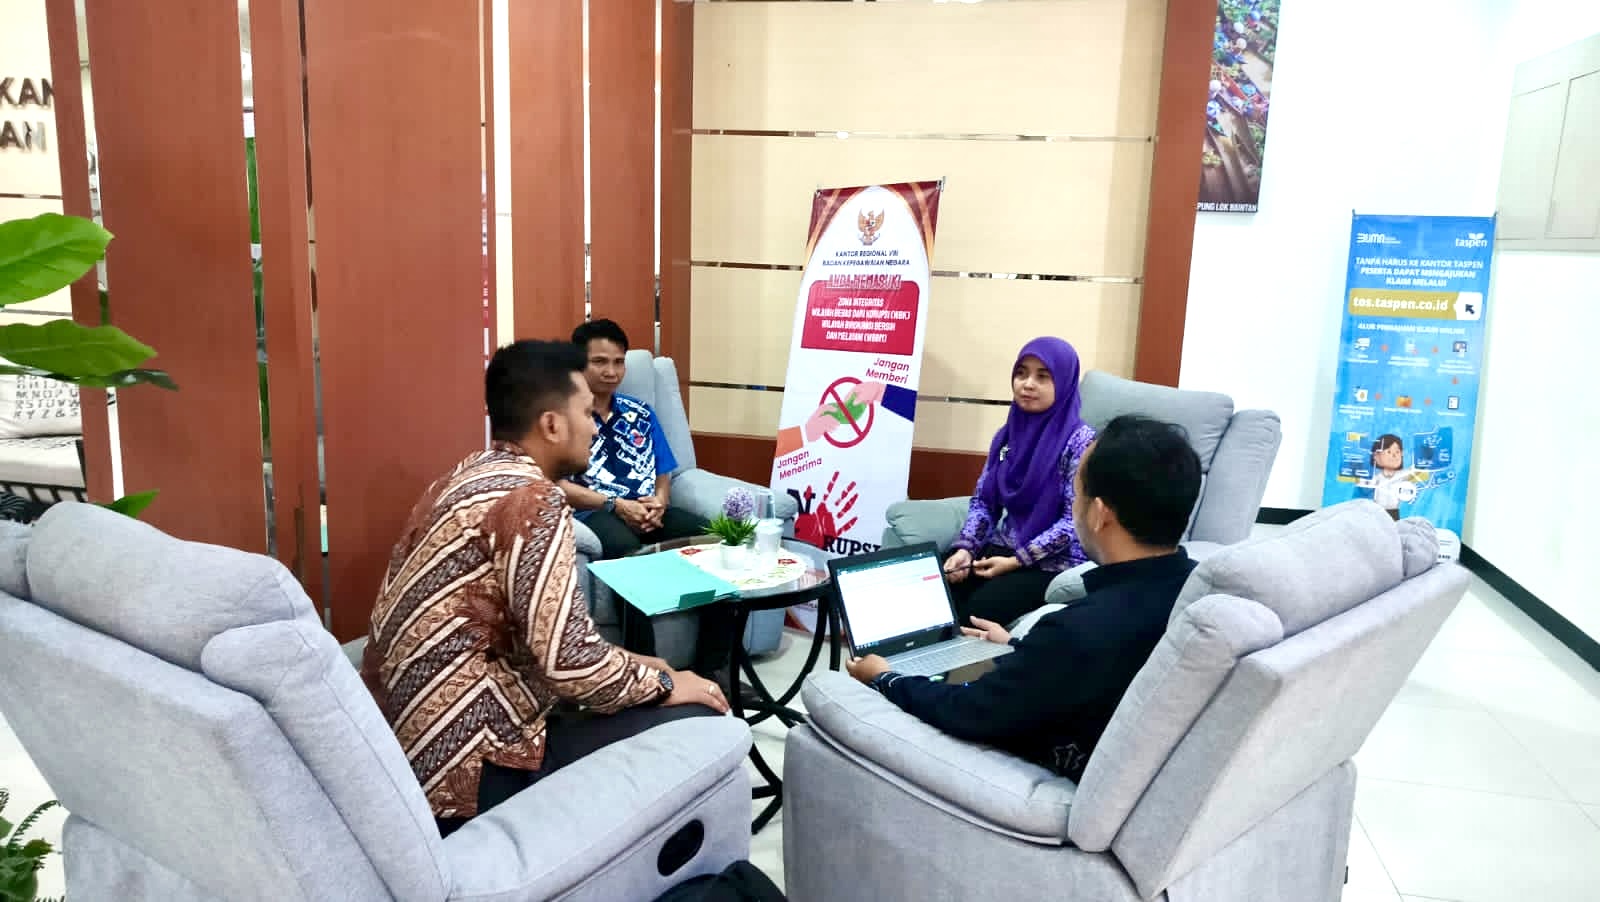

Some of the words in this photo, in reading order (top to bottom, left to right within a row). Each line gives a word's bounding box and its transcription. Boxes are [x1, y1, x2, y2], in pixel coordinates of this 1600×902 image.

[1455, 238, 1488, 248] taspen
[1355, 257, 1381, 266] TANPA
[1382, 258, 1408, 267] HARUS
[1409, 259, 1420, 267] KE
[1420, 259, 1452, 268] KANTOR
[1454, 260, 1484, 269] TASPEN
[1360, 267, 1392, 275] PESERTA
[1393, 268, 1420, 276] DAPAT
[1420, 269, 1476, 279] MENGAJUKAN
[1386, 278, 1411, 286] KLAIM
[1412, 278, 1447, 287] MELALUI
[838, 297, 852, 307] ZONA
[1353, 297, 1448, 311] tos.taspen.co.id
[811, 308, 834, 317] WILAYAH
[866, 309, 890, 319] KORUPSI
[822, 320, 845, 329] WILAYAH
[826, 331, 838, 340] DAN
[873, 358, 910, 372] Jangan
[865, 368, 908, 384] Memberi
[777, 450, 810, 469] Jangan
[779, 458, 822, 480] Menerima
